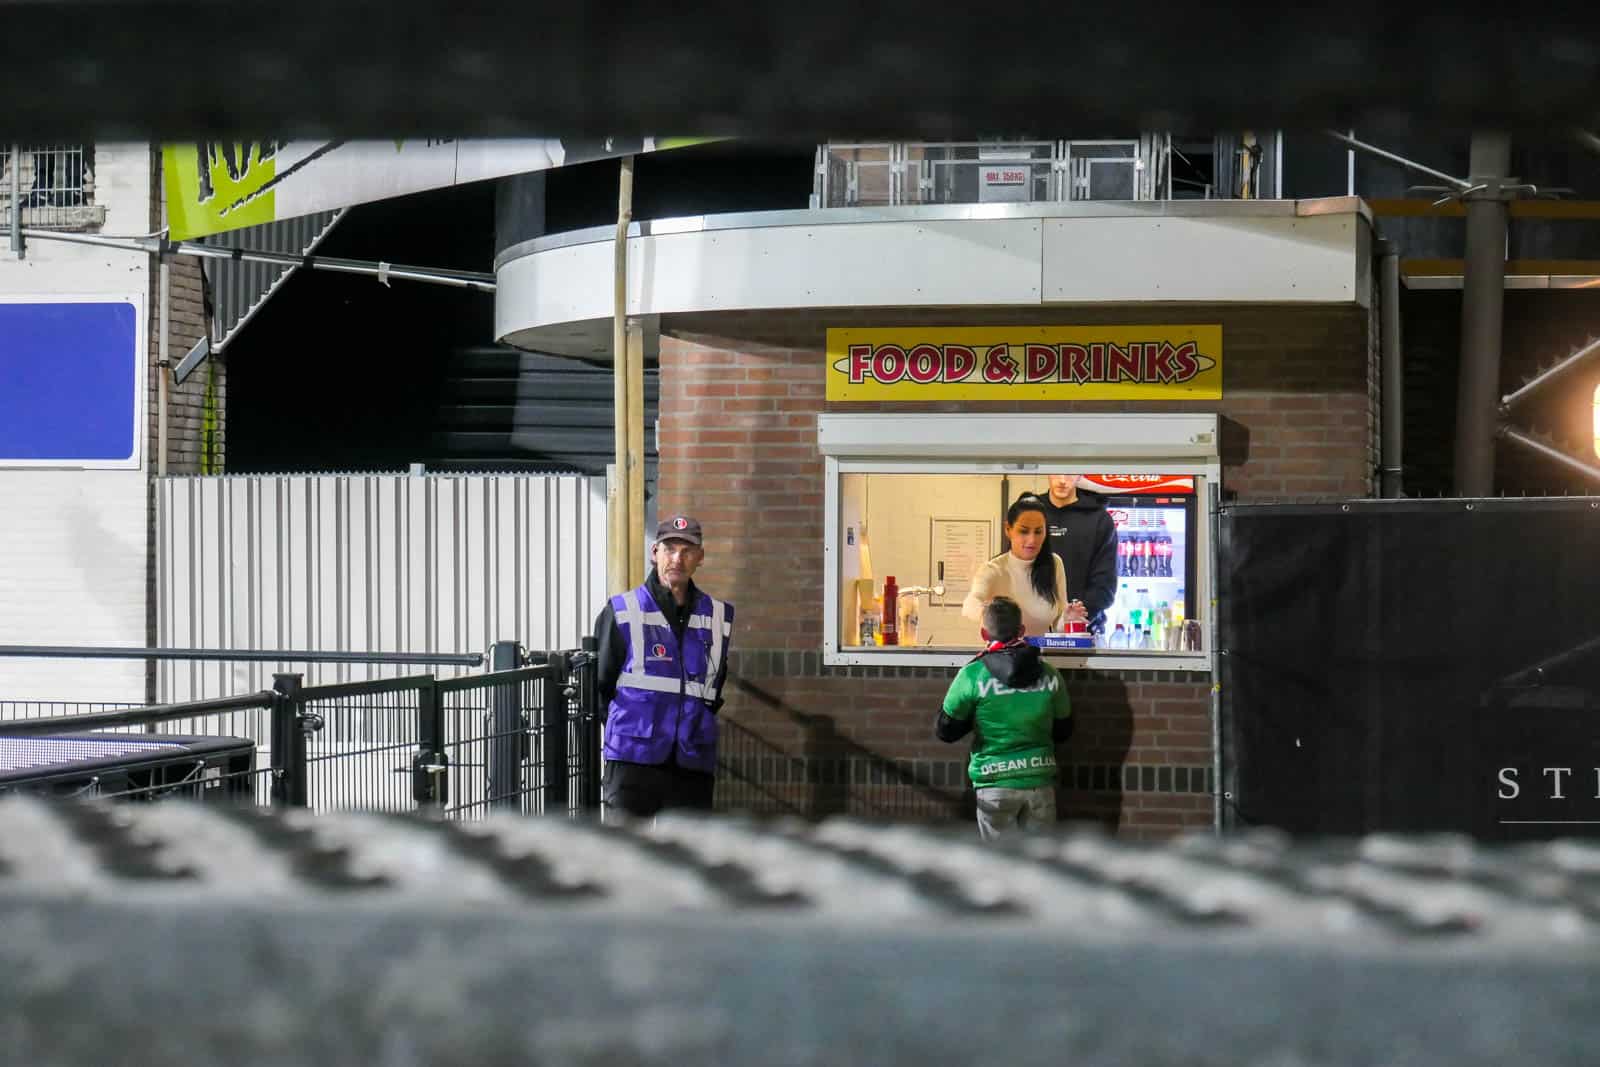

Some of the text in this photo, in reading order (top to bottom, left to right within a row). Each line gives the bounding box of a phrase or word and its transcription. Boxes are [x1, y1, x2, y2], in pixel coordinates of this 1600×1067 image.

[848, 340, 1200, 386] FOOD & DRINKS
[980, 758, 1027, 776] OCEAN
